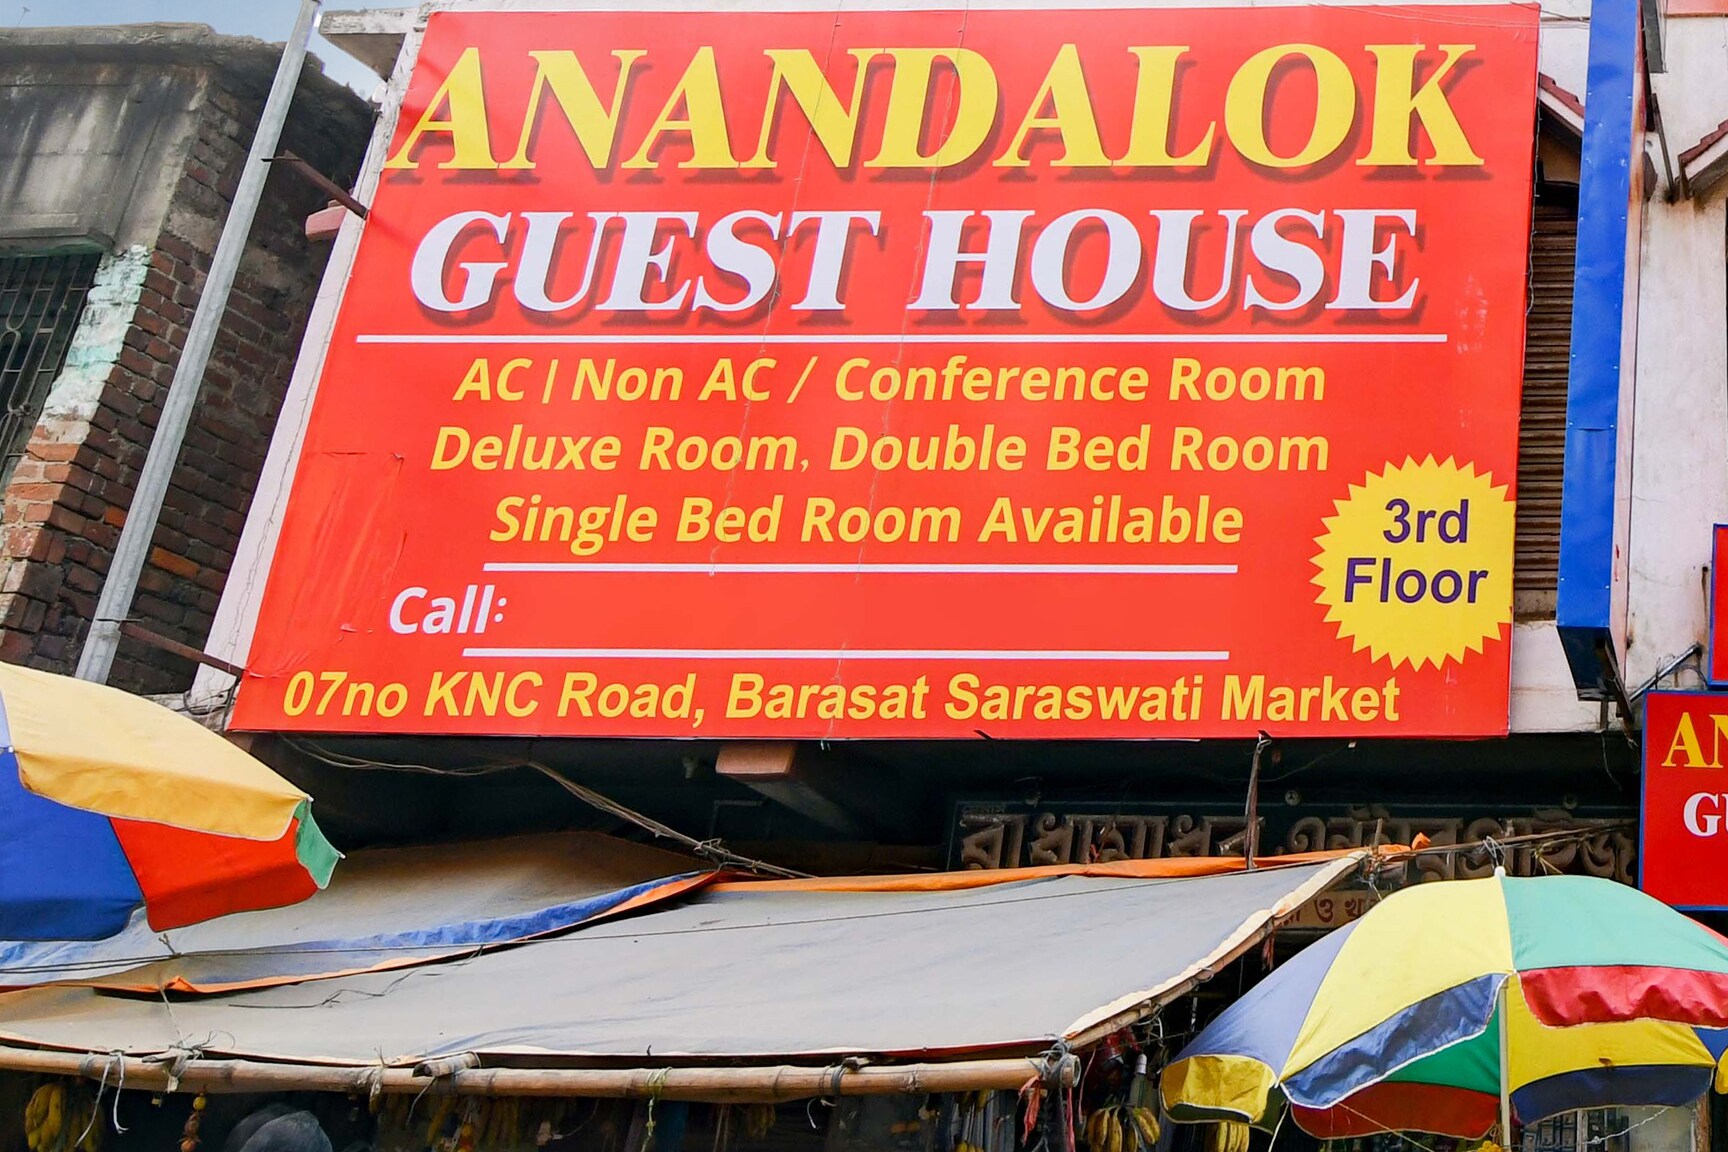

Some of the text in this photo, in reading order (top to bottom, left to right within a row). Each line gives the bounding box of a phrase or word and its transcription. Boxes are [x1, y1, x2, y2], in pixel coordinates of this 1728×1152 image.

[386, 44, 1482, 169] ANANDALOK
[410, 205, 1418, 312] GUEST HOUSE
[454, 359, 530, 402] AC
[574, 358, 683, 402] Non
[700, 359, 776, 402] AC
[834, 355, 1149, 402] Conference
[1168, 358, 1327, 402] Room
[430, 425, 618, 472] Deluxe
[828, 423, 1028, 472] Double
[1045, 423, 1152, 472] Bed
[1172, 428, 1330, 472] Room
[489, 493, 1243, 553] Single Bed Room Available
[1383, 498, 1470, 545] 3rd
[1341, 558, 1487, 606] Floor
[388, 583, 506, 635] Call:
[284, 672, 1400, 728] 07no KNC Road, Barasat Saraswati Market
